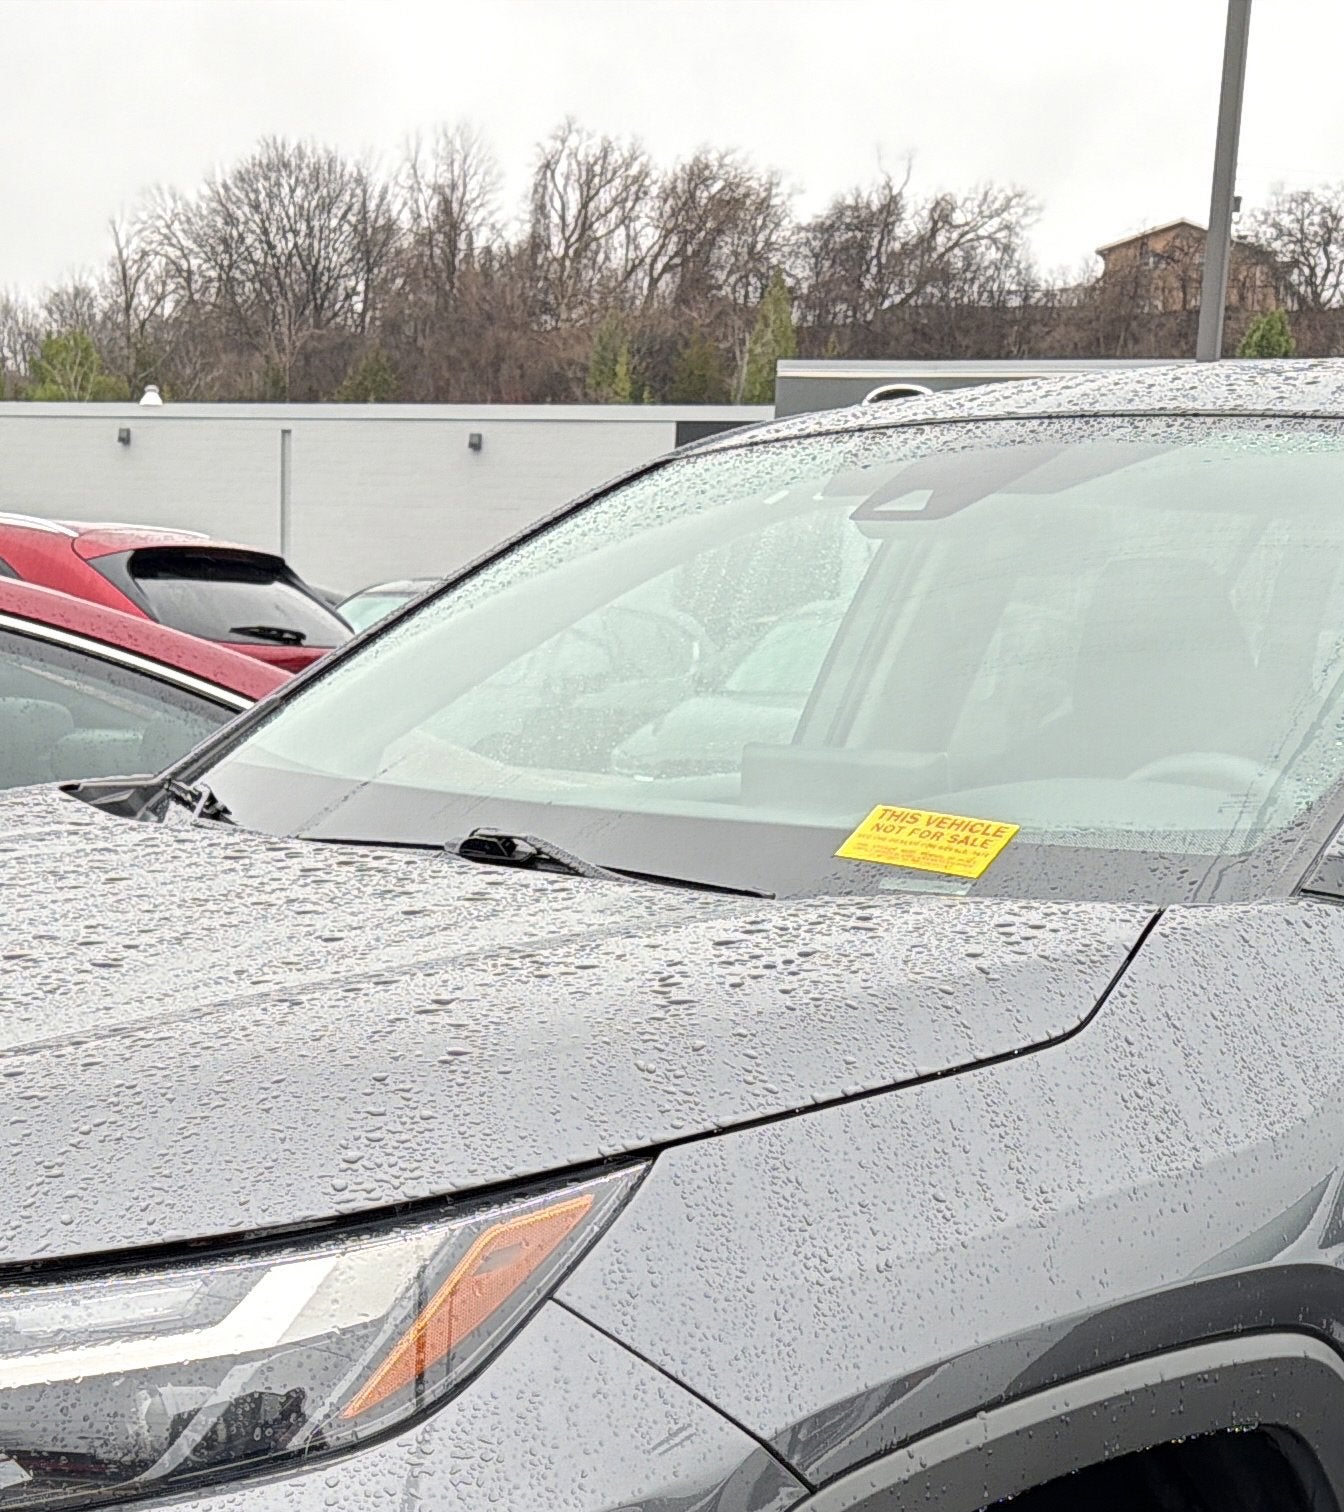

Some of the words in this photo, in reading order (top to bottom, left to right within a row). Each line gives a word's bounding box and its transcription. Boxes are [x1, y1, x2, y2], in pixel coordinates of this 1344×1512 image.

[871, 823, 903, 837] NOT
[908, 828, 943, 843] FOR
[947, 834, 993, 850] SALE
[879, 808, 922, 824] THIS
[926, 814, 1010, 839] VEHICLE
